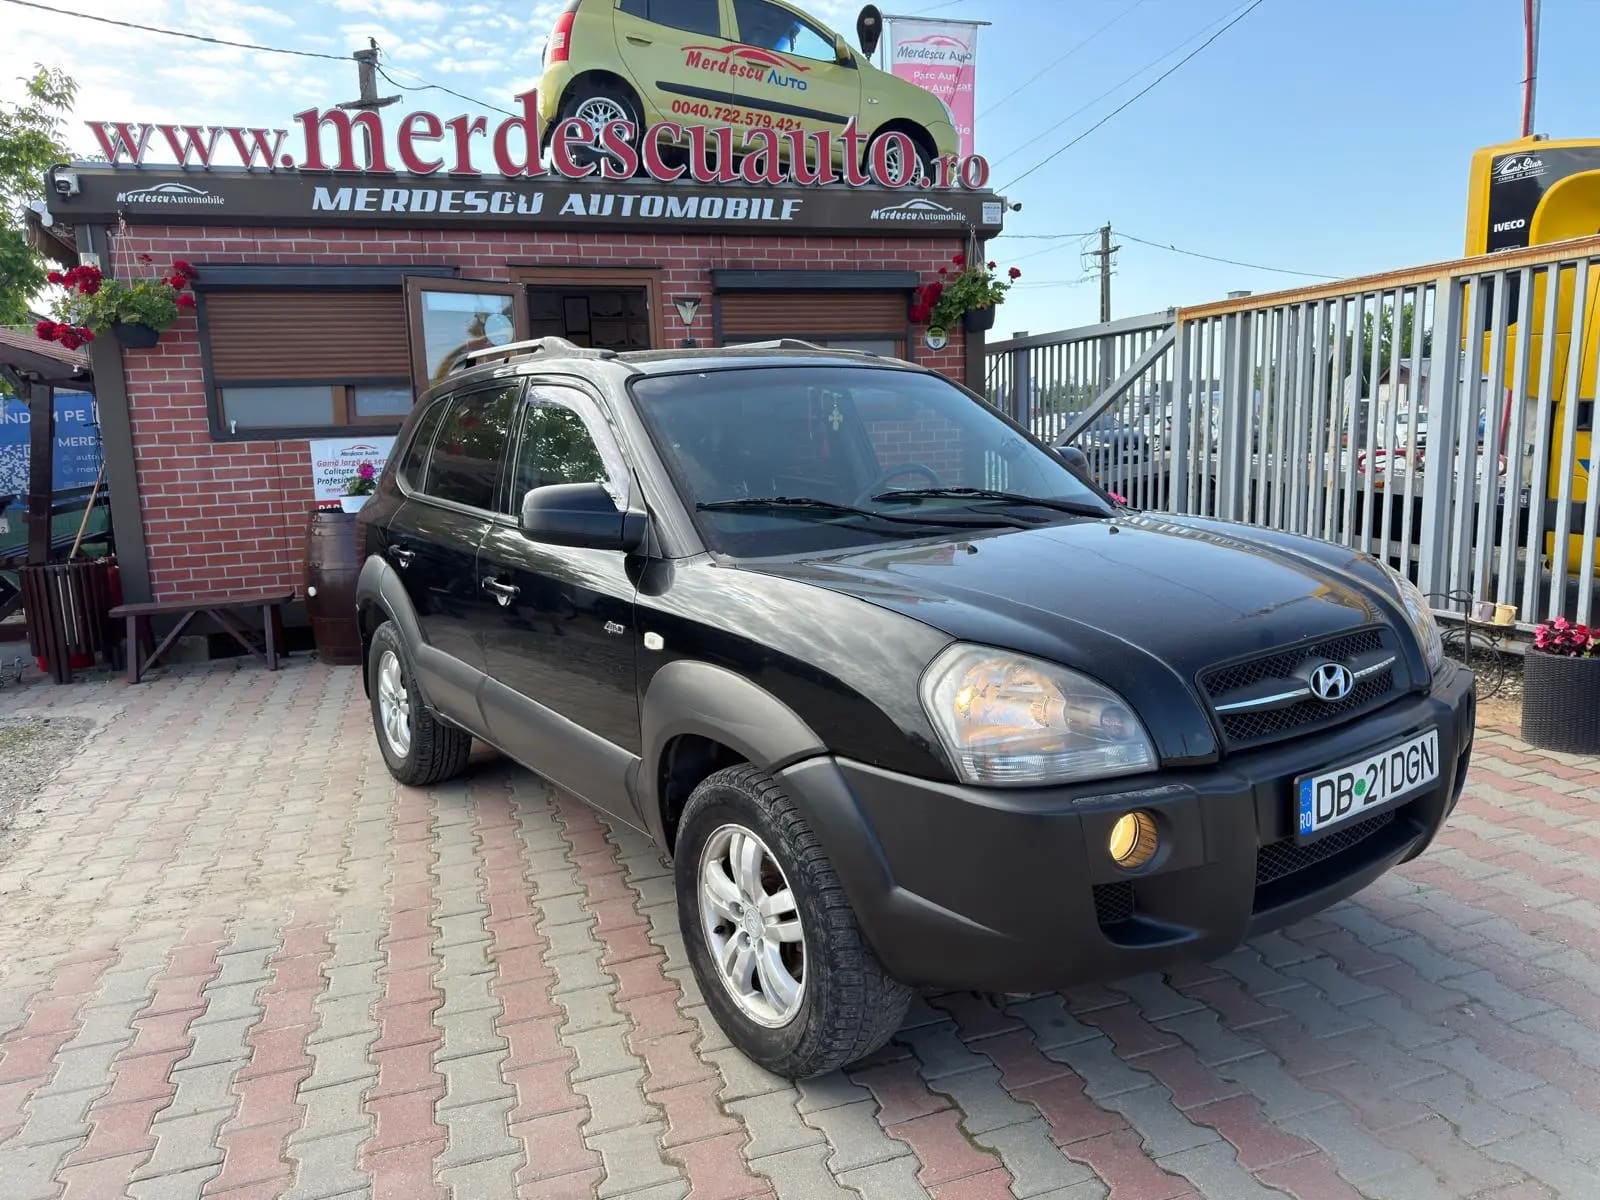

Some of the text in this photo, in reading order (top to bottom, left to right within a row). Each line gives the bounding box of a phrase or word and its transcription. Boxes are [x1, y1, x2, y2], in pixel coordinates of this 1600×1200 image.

[897, 46, 946, 60] Merdescu
[685, 50, 808, 91] Merdescu AUTO
[913, 71, 936, 80] Parc
[671, 99, 804, 132] 0040.722.579.421
[84, 89, 990, 190] www.merdescuauto.ro
[312, 186, 804, 221] MERDESCU AUTOMOBILE
[1493, 219, 1526, 233] IVECO
[64, 409, 87, 422] PE
[324, 468, 355, 476] Calitate
[1316, 736, 1435, 825] DB 21 DGN
[1300, 811, 1312, 830] RO
